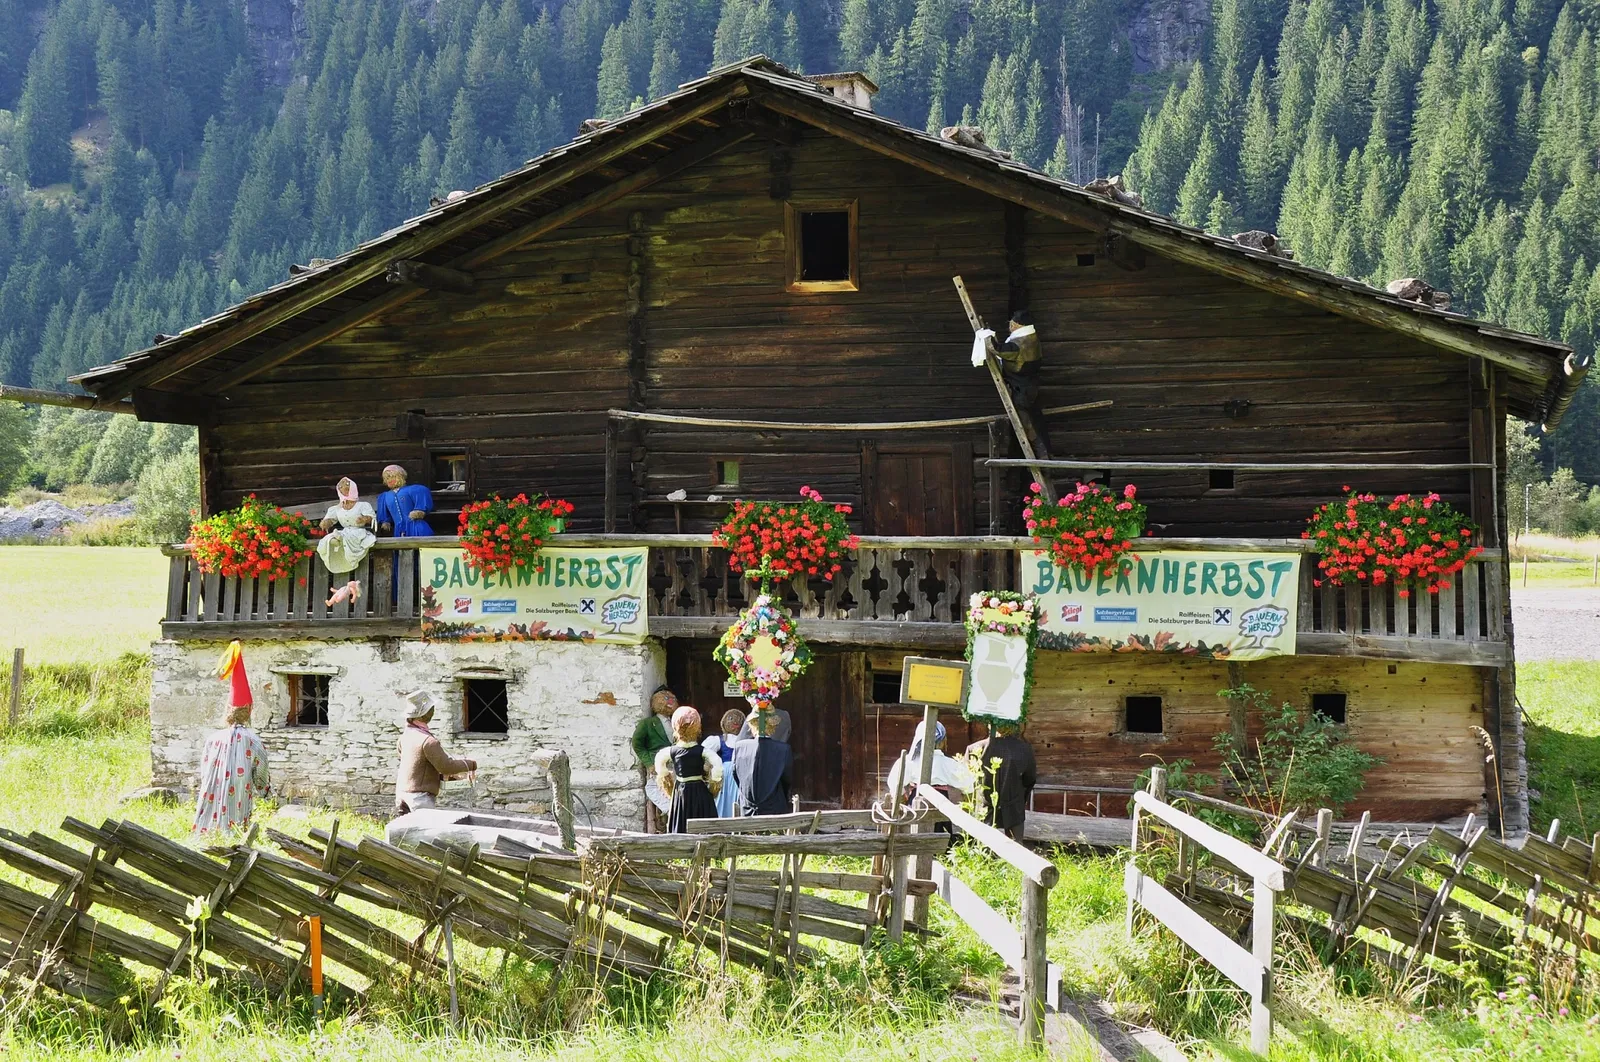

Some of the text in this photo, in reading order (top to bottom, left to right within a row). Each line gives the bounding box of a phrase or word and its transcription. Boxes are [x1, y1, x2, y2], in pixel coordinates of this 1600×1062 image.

[609, 600, 637, 612] BAUERN
[1062, 604, 1082, 617] Stiegl
[608, 610, 634, 621] HERBST
[1248, 611, 1283, 624] BAUERN
[1160, 618, 1194, 626] Salzburger
[1247, 622, 1278, 633] HERBST
